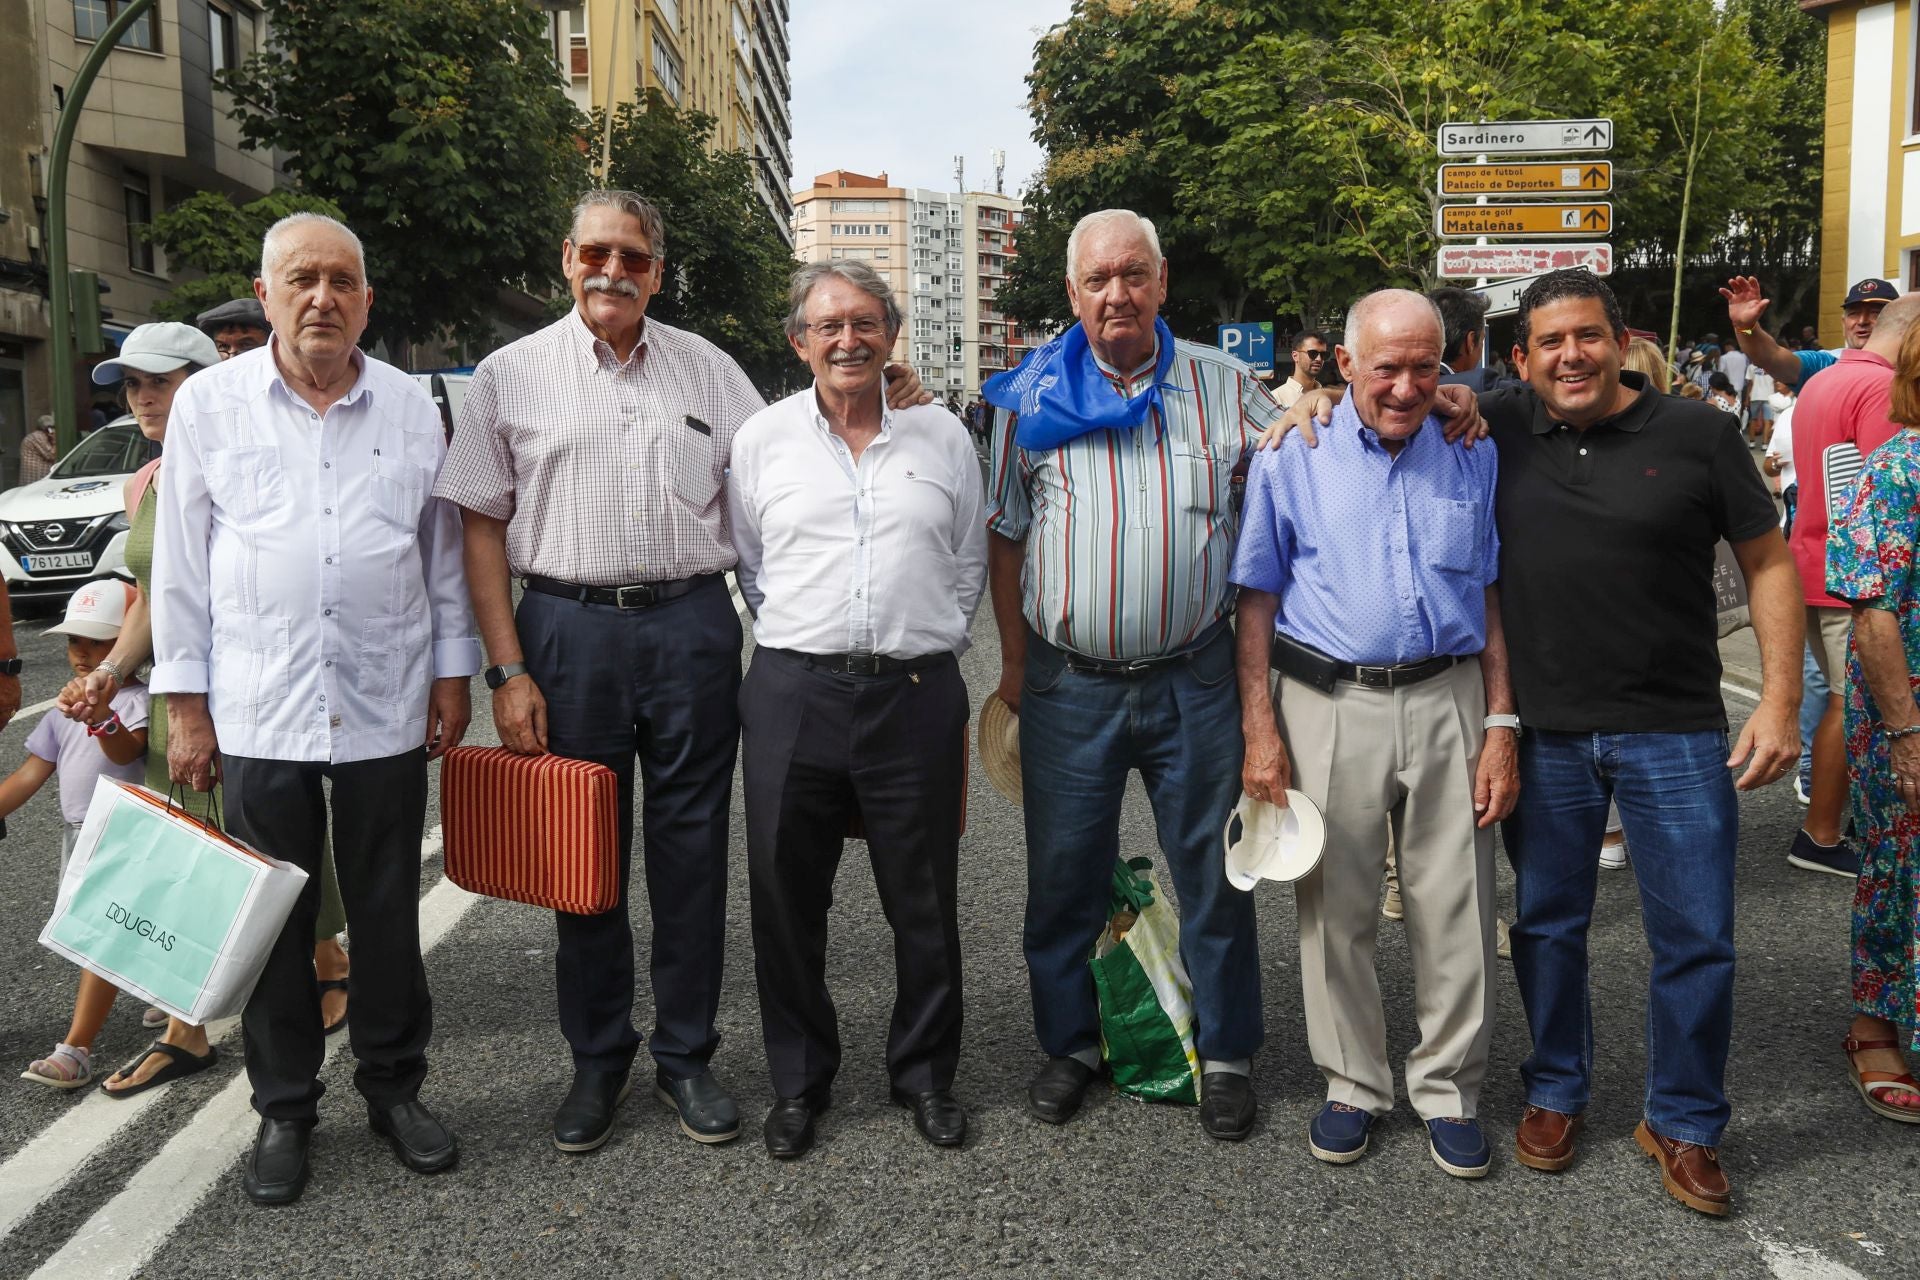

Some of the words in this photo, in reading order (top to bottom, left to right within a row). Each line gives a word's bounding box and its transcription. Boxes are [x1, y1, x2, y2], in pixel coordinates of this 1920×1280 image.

[1447, 132, 1525, 145] Sardinero
[1447, 170, 1477, 178] campo
[1480, 169, 1491, 177] de
[1495, 168, 1523, 176] fútbol
[1447, 181, 1485, 189] Palacio
[1489, 180, 1502, 189] de
[1506, 179, 1555, 190] Deportes
[1447, 210, 1477, 218] campo
[1480, 208, 1491, 216] de
[1495, 208, 1513, 218] golf
[1446, 219, 1524, 232] Mataleñas
[1222, 328, 1243, 353] P
[30, 556, 63, 569] 7612
[66, 552, 91, 567] LLH
[1729, 577, 1737, 588] &
[1717, 593, 1738, 608] TH
[105, 902, 176, 952] DOUGLAS
